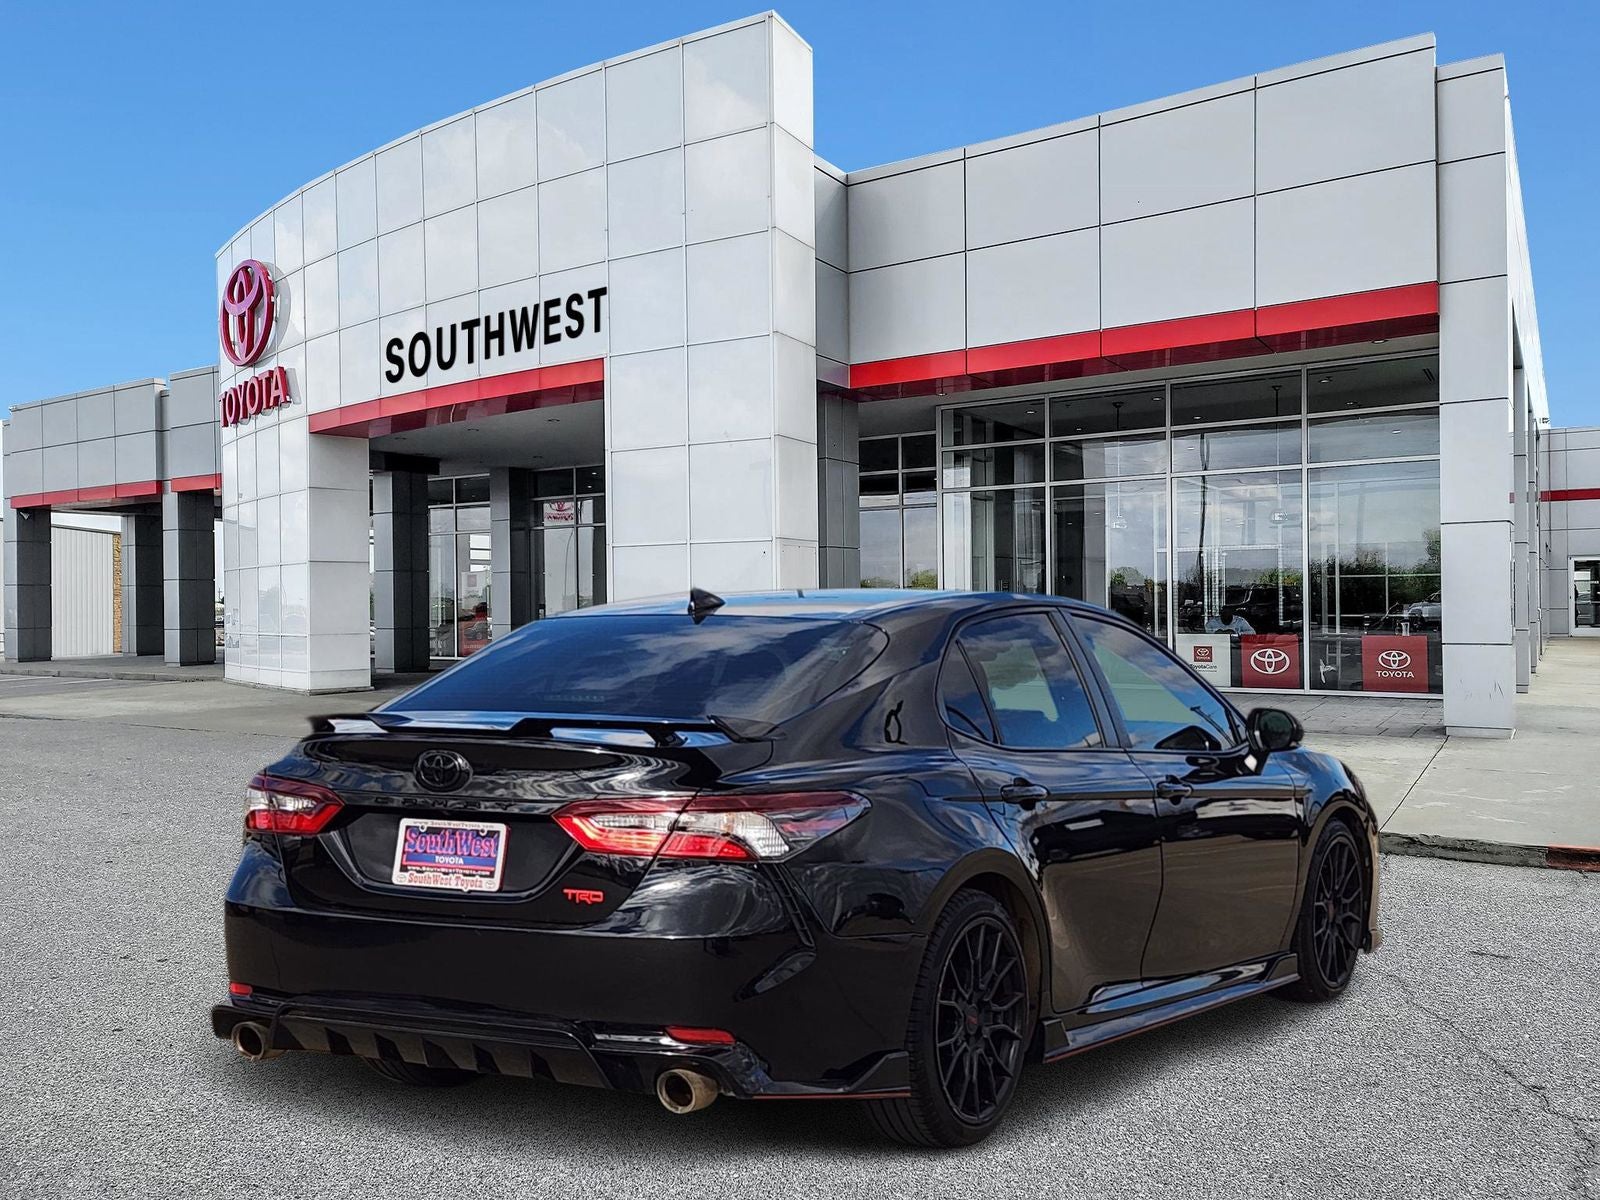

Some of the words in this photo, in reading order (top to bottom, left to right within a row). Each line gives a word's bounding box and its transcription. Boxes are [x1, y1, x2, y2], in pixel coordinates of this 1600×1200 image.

[385, 287, 607, 384] SOUTHWEST
[218, 366, 290, 427] TOYOTA
[1376, 670, 1414, 678] TOYOTA
[435, 856, 464, 865] TOYOTA
[455, 877, 483, 889] Toyota
[563, 889, 603, 904] TRD
